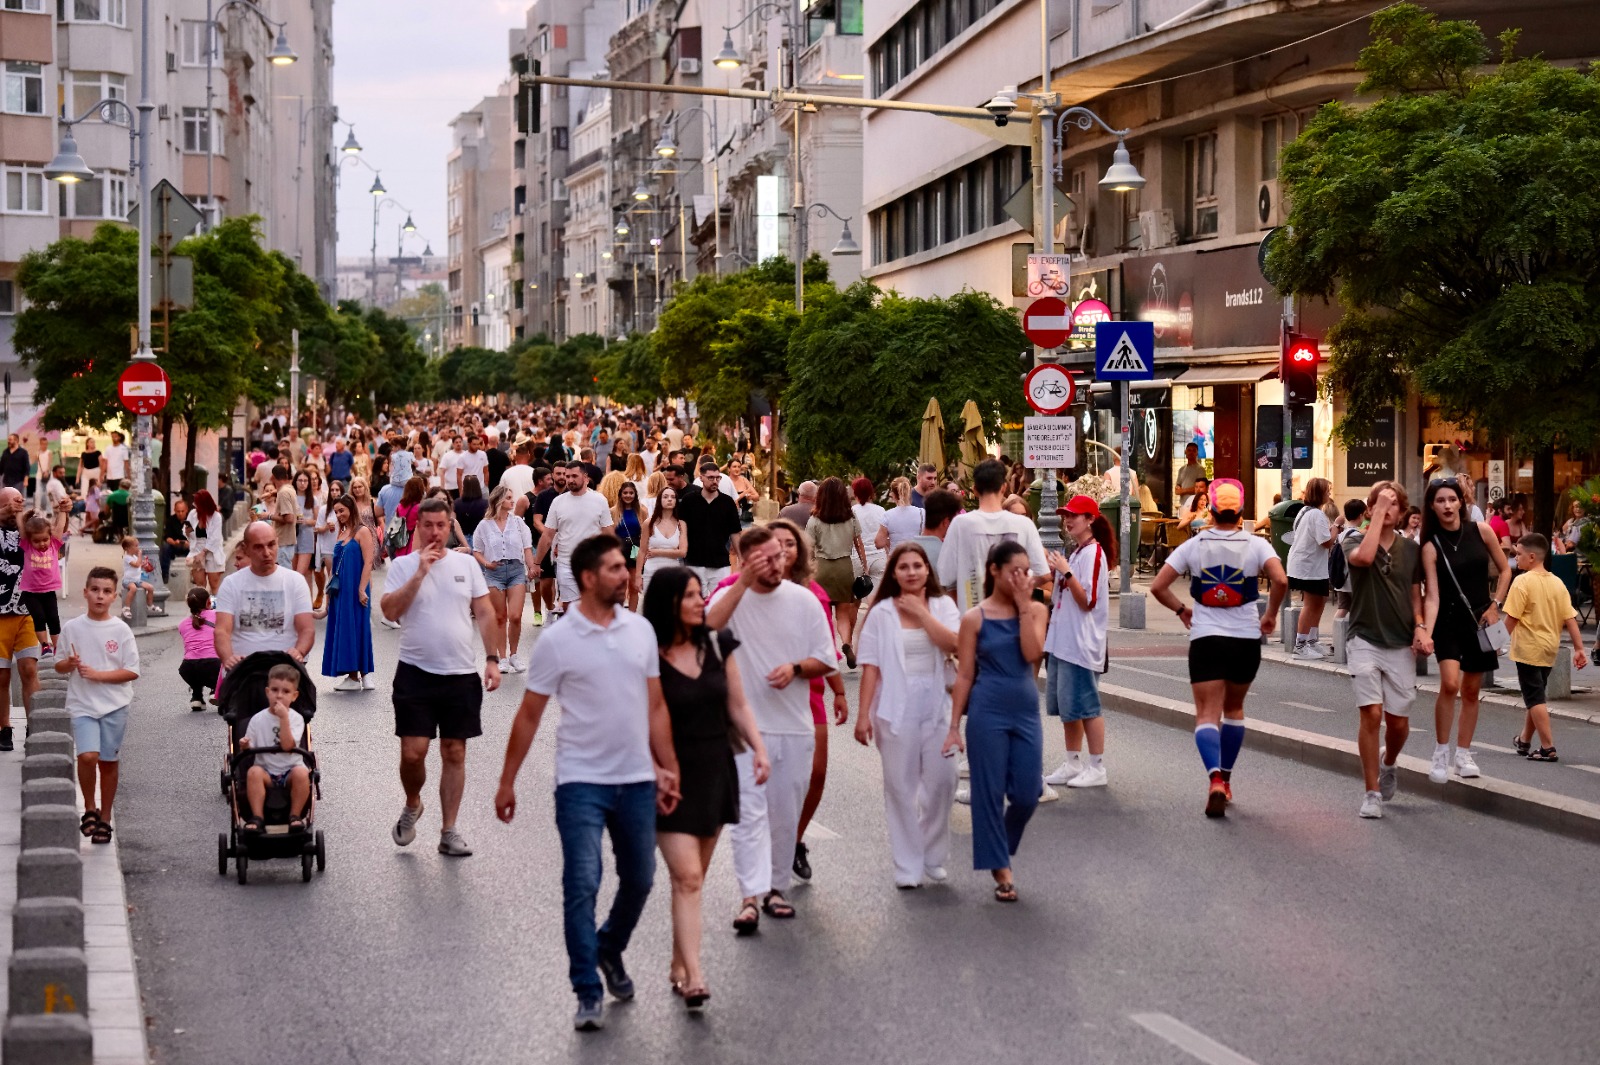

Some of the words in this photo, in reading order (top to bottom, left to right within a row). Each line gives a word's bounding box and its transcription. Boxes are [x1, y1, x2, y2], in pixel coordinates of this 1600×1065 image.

[1225, 287, 1263, 307] brands112
[1074, 313, 1111, 325] COSTA
[1353, 462, 1388, 470] JONAK
